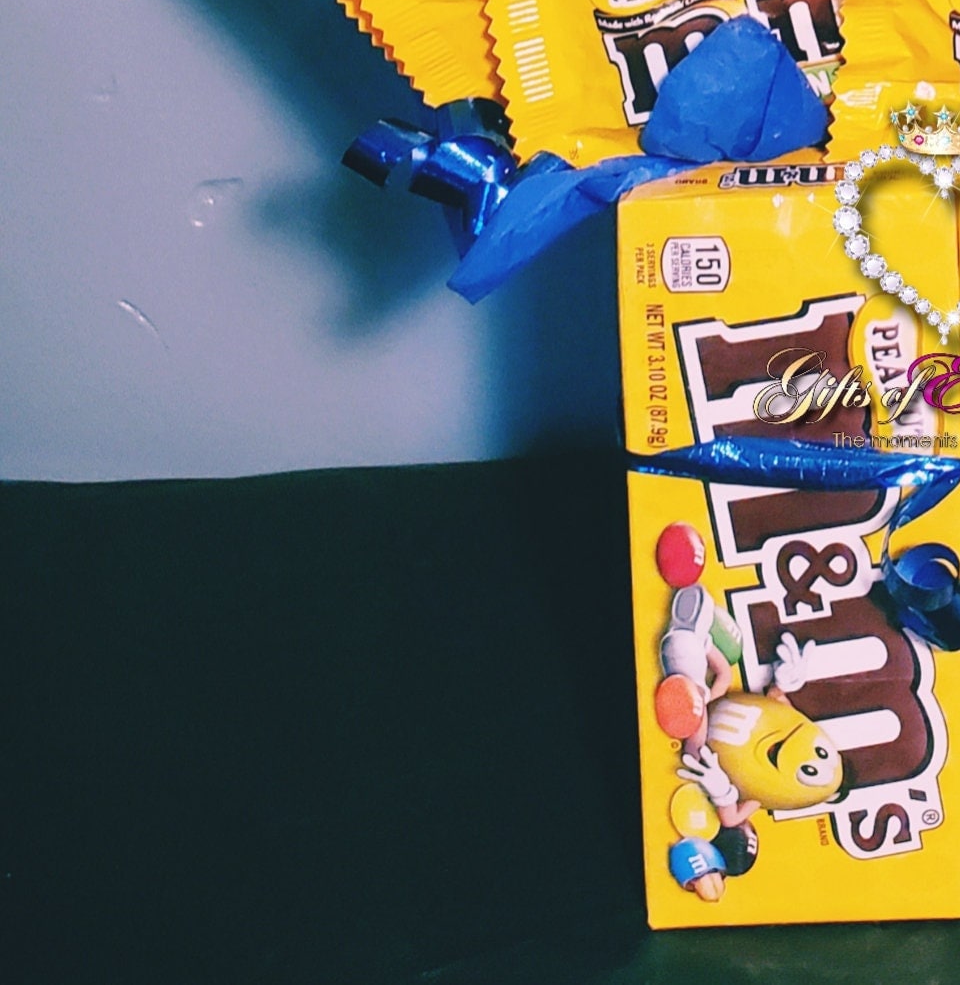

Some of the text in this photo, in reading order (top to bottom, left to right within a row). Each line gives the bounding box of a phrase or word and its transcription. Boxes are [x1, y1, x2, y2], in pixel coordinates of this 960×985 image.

[635, 247, 645, 285] PER PACK
[646, 249, 656, 289] SERVINGS
[671, 256, 681, 288] SERVING
[680, 242, 692, 287] CALORIES
[695, 244, 722, 287] 150
[646, 304, 669, 449] NET WT 3.10 OZ (87.9g)
[815, 817, 829, 847] BRAND
